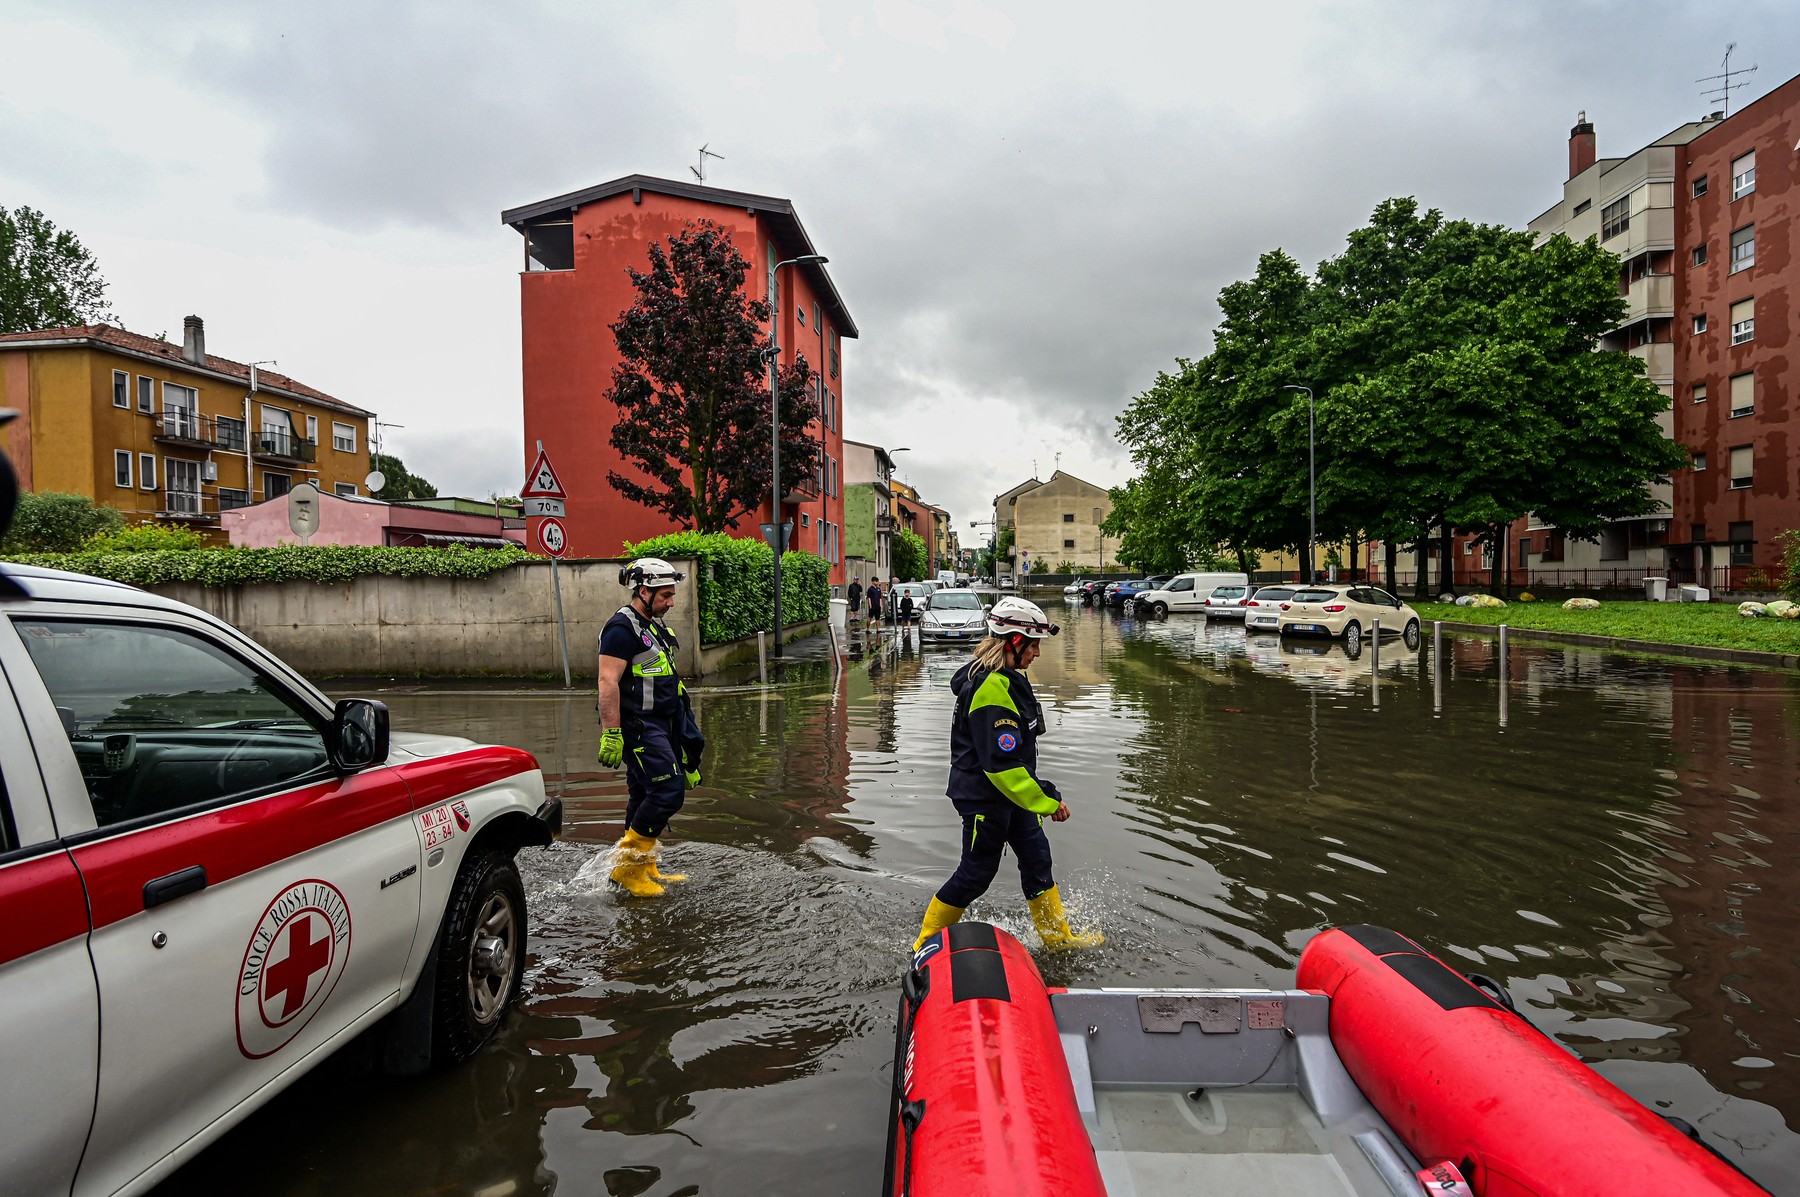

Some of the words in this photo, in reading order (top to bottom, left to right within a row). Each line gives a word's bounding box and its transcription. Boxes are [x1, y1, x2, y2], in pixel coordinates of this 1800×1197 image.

[537, 502, 551, 512] 70
[421, 813, 434, 828] MI
[436, 807, 447, 822] 20
[426, 830, 437, 846] 23
[442, 825, 452, 839] 84
[240, 926, 273, 996] CROCE
[269, 886, 309, 928] ROSSA
[312, 884, 348, 945] ITALIANA
